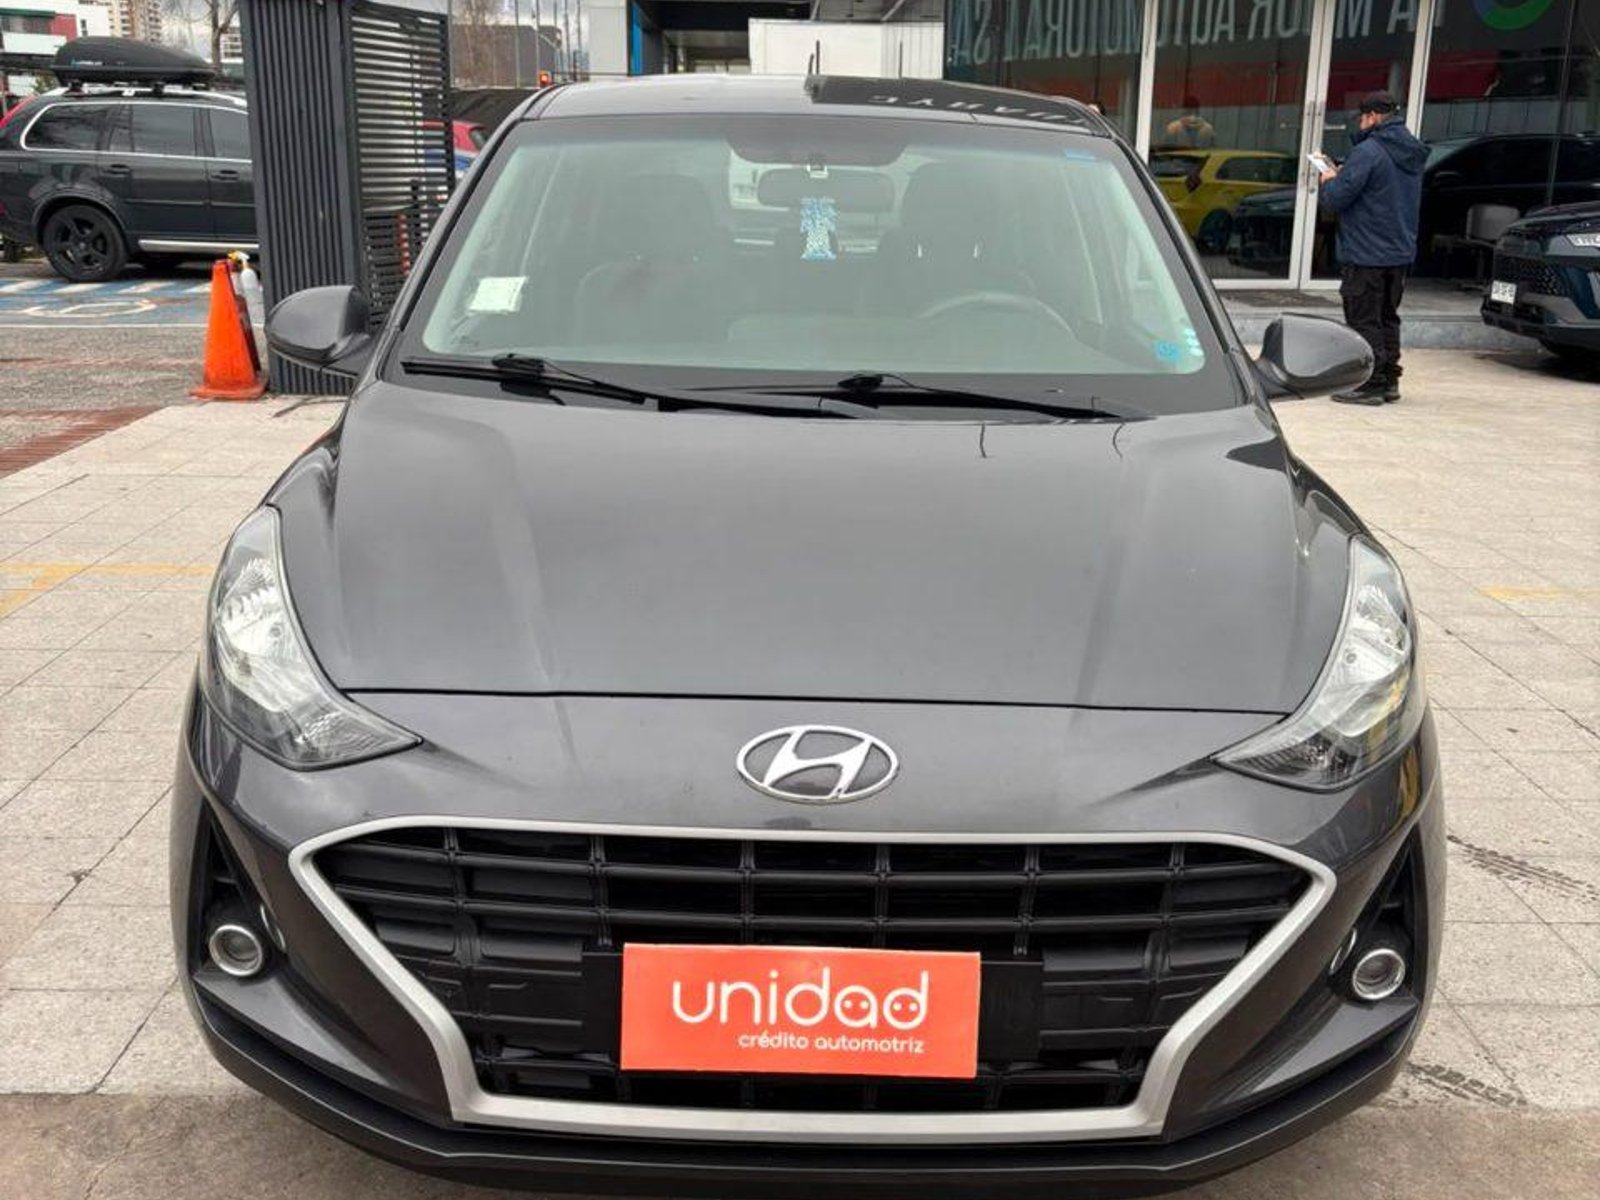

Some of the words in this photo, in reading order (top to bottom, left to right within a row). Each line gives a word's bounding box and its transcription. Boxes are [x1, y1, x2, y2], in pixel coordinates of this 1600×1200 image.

[672, 966, 929, 1030] unidad
[738, 1031, 809, 1050] crédito
[814, 1035, 924, 1054] automotriz
